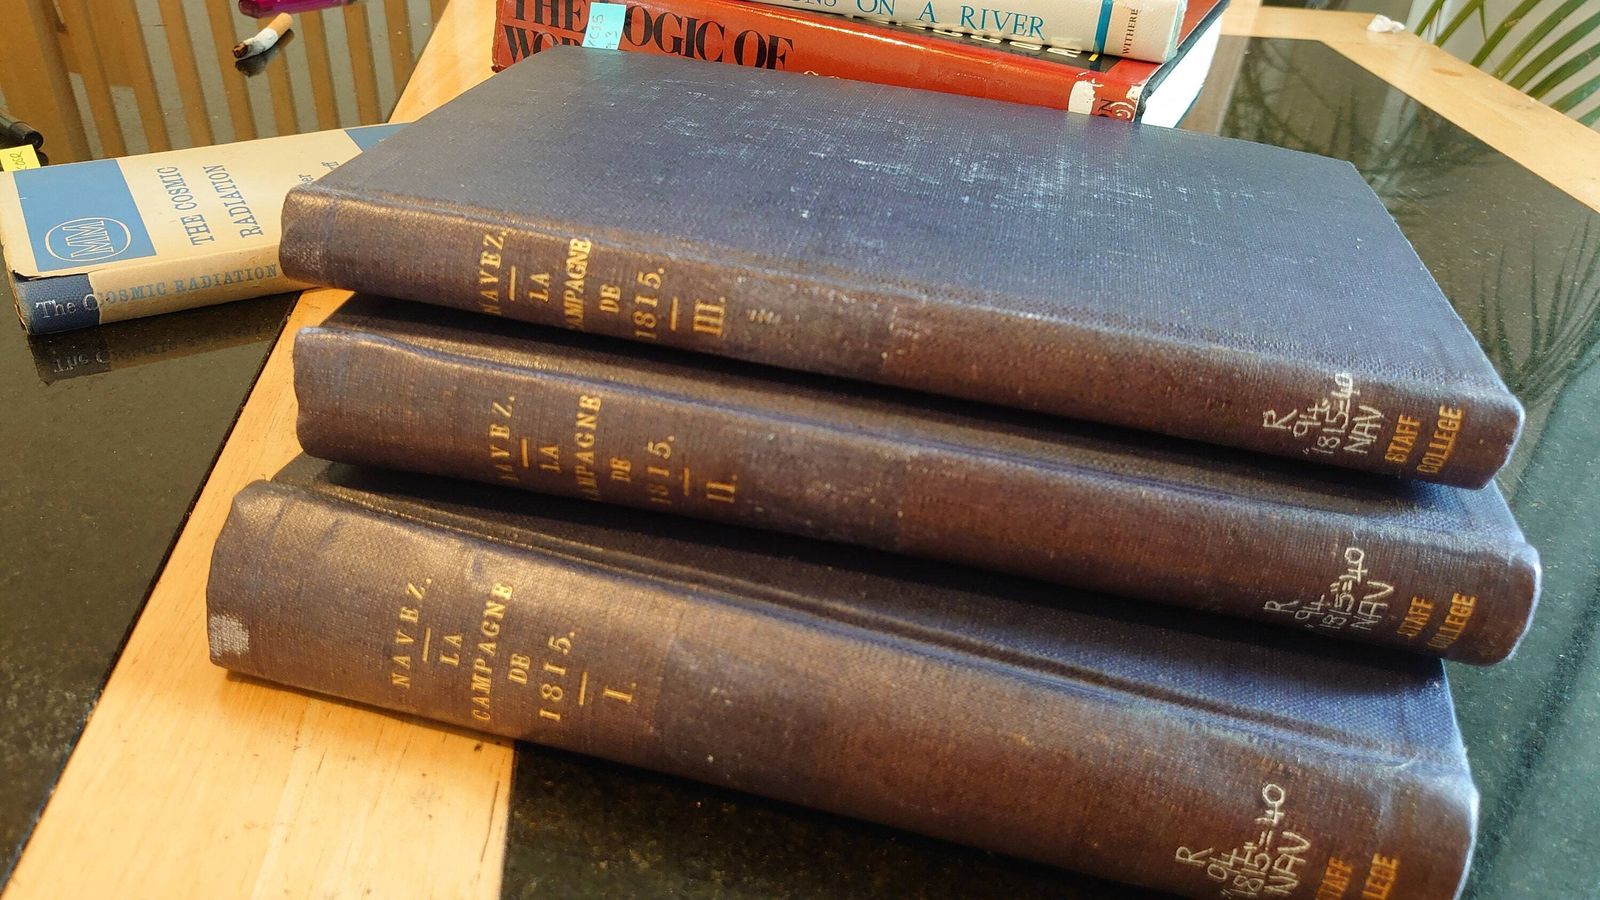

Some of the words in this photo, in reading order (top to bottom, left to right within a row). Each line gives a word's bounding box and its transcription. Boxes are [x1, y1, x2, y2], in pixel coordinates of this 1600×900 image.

[514, 0, 588, 33] THE
[622, 5, 726, 63] OGIC
[733, 30, 794, 71] OF
[855, 0, 896, 16] ON
[916, 1, 940, 23] A
[960, 5, 1045, 40] RIVER
[157, 166, 198, 211] COSMIC
[203, 164, 263, 239] RADIATION
[181, 214, 215, 246] THE
[35, 300, 77, 319] The
[174, 264, 277, 293] RADIATION
[528, 272, 550, 302] LA
[563, 238, 592, 333] AMPAGNE
[600, 284, 621, 313] DE
[633, 267, 665, 340] 1815.
[692, 296, 727, 338] III.
[1262, 408, 1298, 431] R
[1343, 405, 1385, 454] NAV
[1385, 414, 1421, 464] STAFF
[1416, 404, 1463, 475] COLLEGE
[538, 444, 560, 473] LA
[574, 394, 602, 502] AMPAGNE
[610, 456, 631, 483] DE
[705, 474, 738, 504] II.
[1263, 599, 1299, 613] R
[1350, 580, 1395, 631] NAV
[1397, 596, 1435, 639] STAFF
[1427, 592, 1477, 649] COLLEGE
[391, 578, 432, 689] NAVEZ.
[440, 633, 462, 667] LA
[471, 583, 513, 721] CAMPAGNE
[507, 653, 531, 685] DE
[539, 631, 576, 722] 1815.
[602, 682, 638, 704] I.
[1175, 845, 1214, 866] R
[1263, 831, 1312, 895] NAV
[1315, 855, 1354, 900] TAFF
[1361, 852, 1399, 900] LEGE
